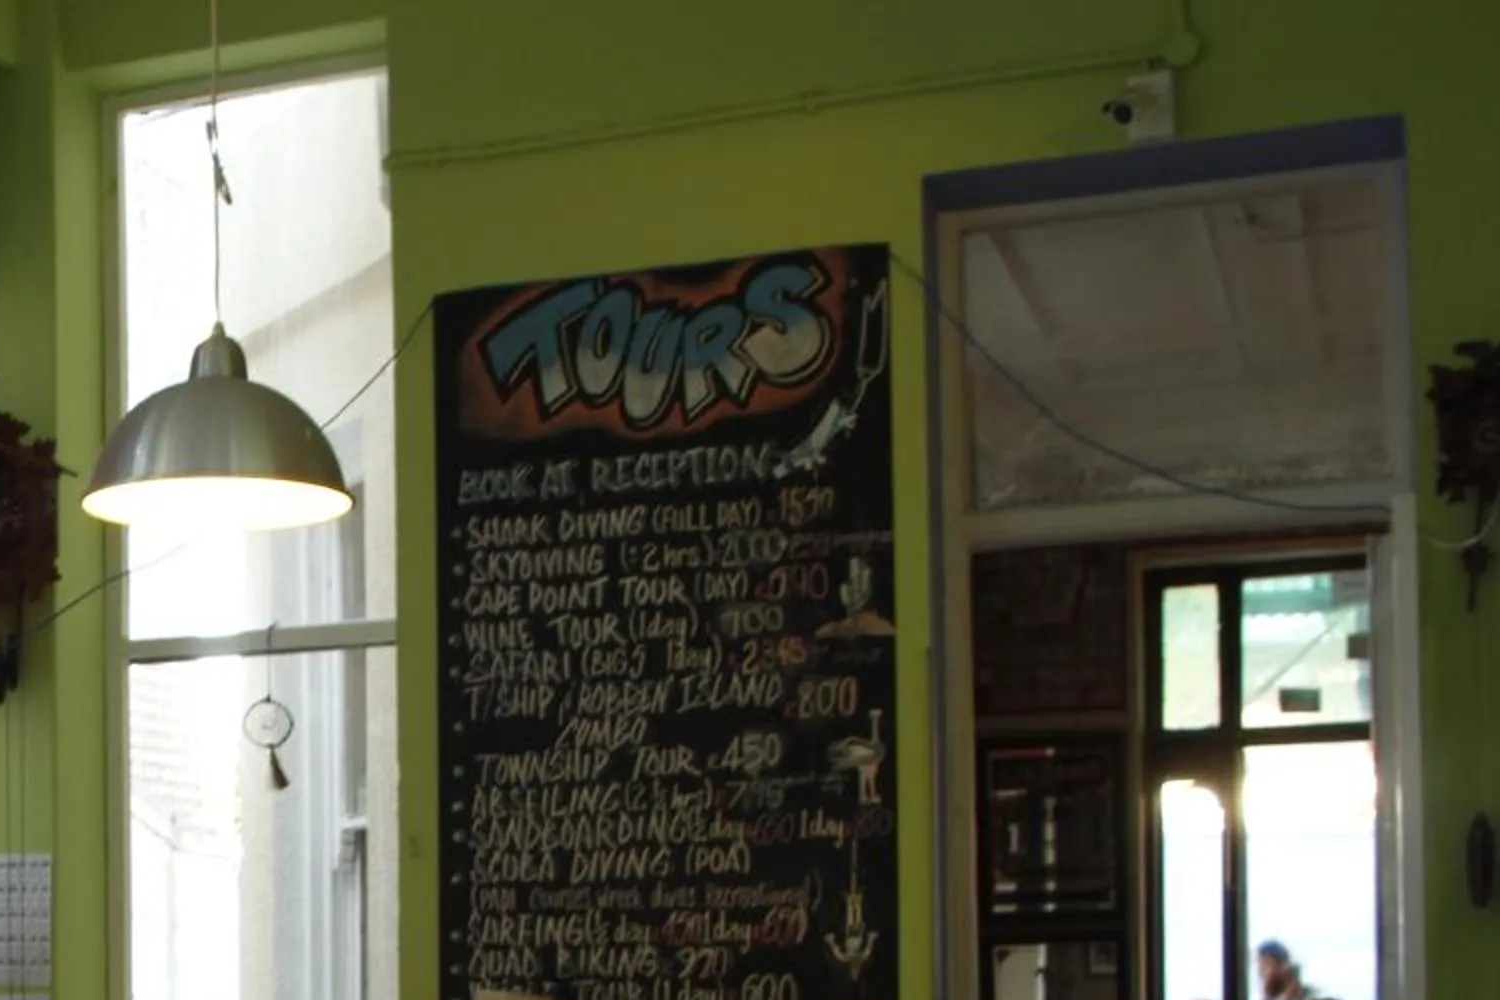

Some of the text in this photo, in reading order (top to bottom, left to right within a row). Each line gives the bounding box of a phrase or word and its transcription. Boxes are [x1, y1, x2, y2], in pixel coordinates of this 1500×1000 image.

[482, 258, 834, 430] TOURS
[458, 464, 533, 504] BOOK
[590, 445, 773, 493] RECEPTION
[467, 514, 551, 550] SHARK
[559, 505, 646, 541] DIVING
[470, 545, 604, 584] SKYDIVING
[462, 583, 521, 619] CAPE
[528, 576, 606, 613] POINT
[619, 574, 692, 611] TOUR
[463, 617, 535, 654] WINE
[548, 612, 626, 652] TOUR
[463, 648, 572, 684] SAFARI
[677, 670, 784, 715] ISLAND
[474, 746, 610, 788] TOWNSHIP
[631, 744, 701, 779] TOUR
[570, 842, 669, 884] DIVING
[685, 838, 750, 879] (POA)
